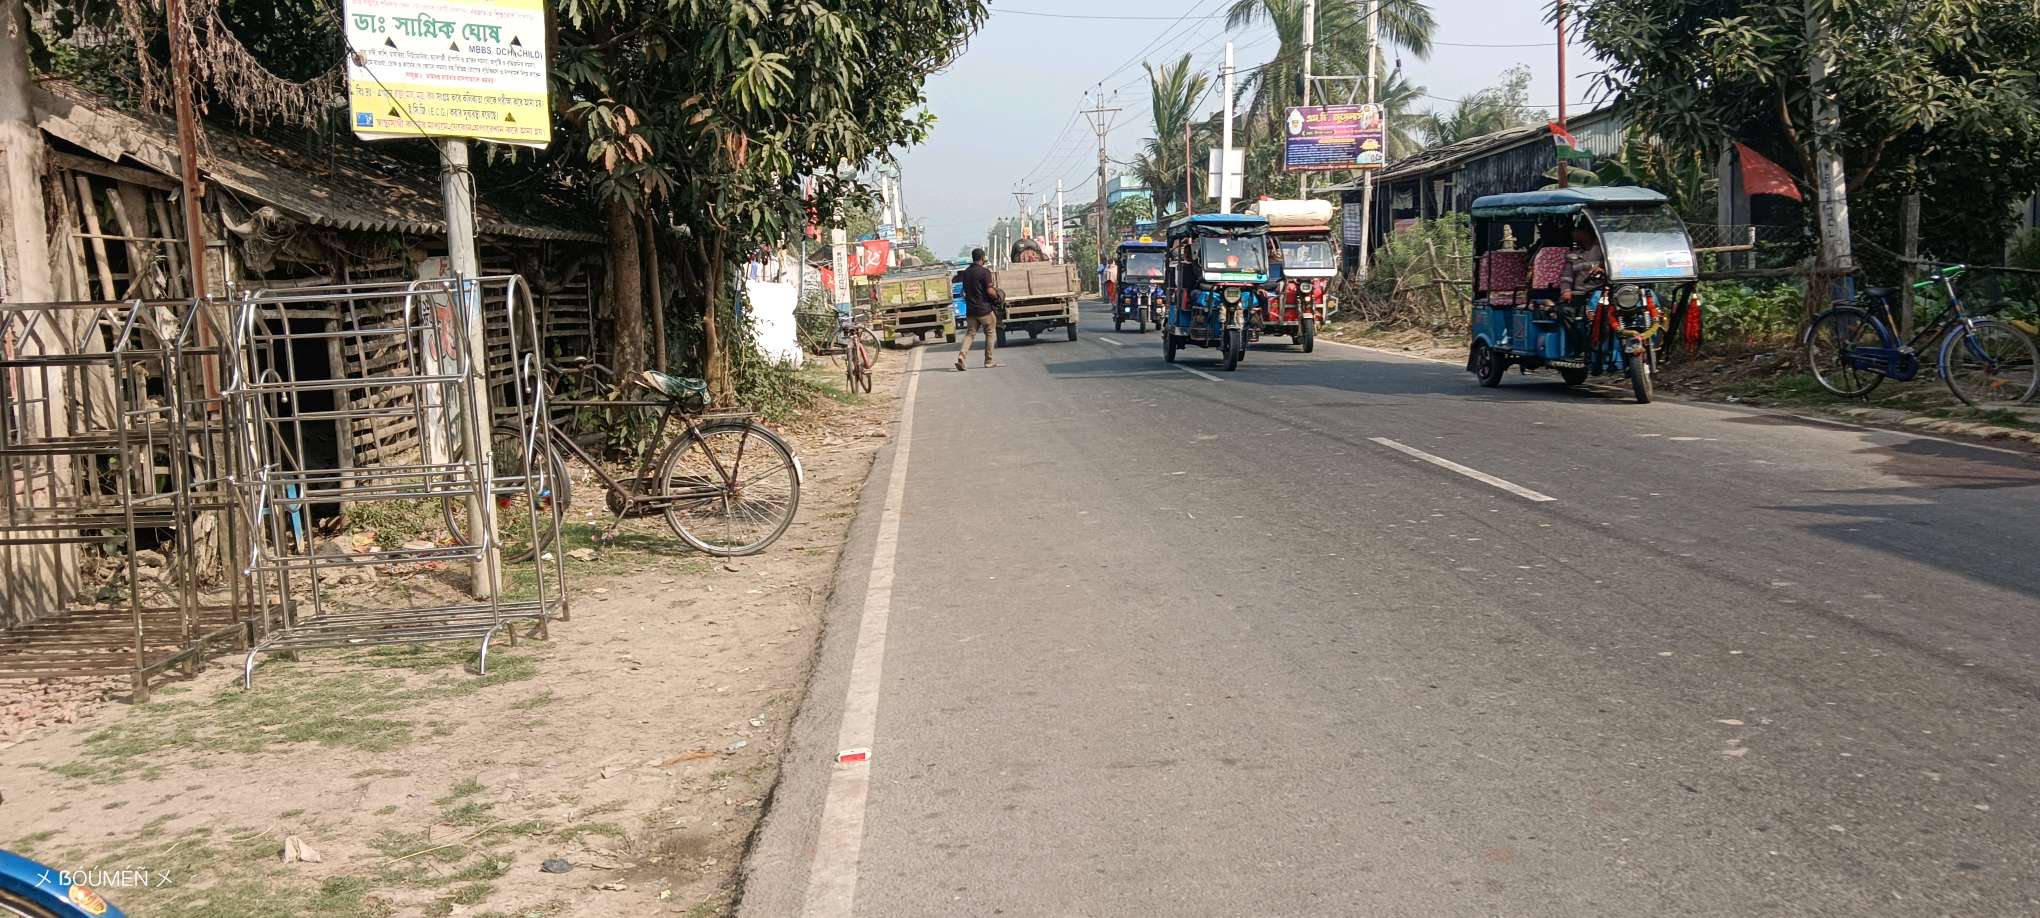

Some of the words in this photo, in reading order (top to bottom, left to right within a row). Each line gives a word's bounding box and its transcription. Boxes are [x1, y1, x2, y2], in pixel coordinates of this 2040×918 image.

[352, 13, 387, 34] ডাঃ
[392, 12, 456, 39] সাগ্নিক
[462, 22, 502, 44] ঘোষ
[469, 45, 492, 56] MBBS
